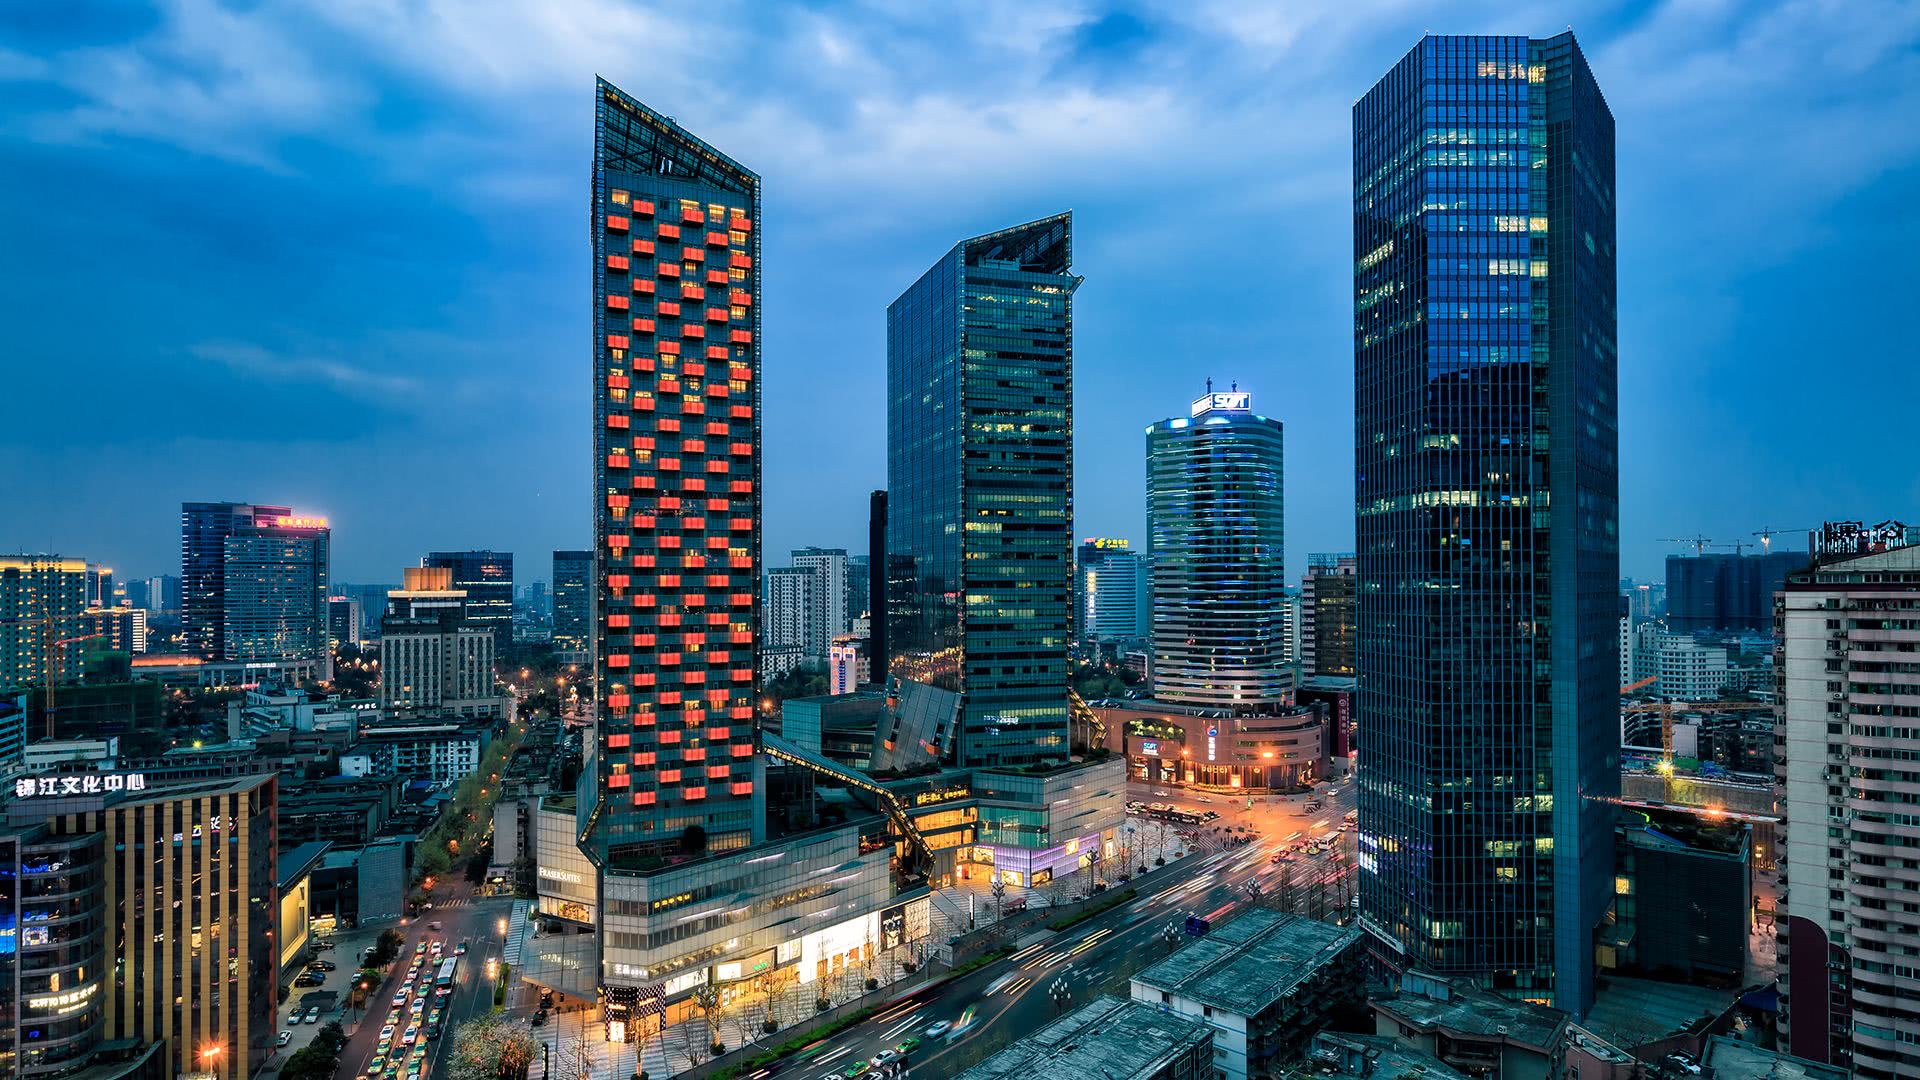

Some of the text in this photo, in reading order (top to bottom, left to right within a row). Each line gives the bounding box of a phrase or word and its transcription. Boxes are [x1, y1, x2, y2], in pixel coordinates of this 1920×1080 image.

[15, 773, 146, 797] 锦江文化中心
